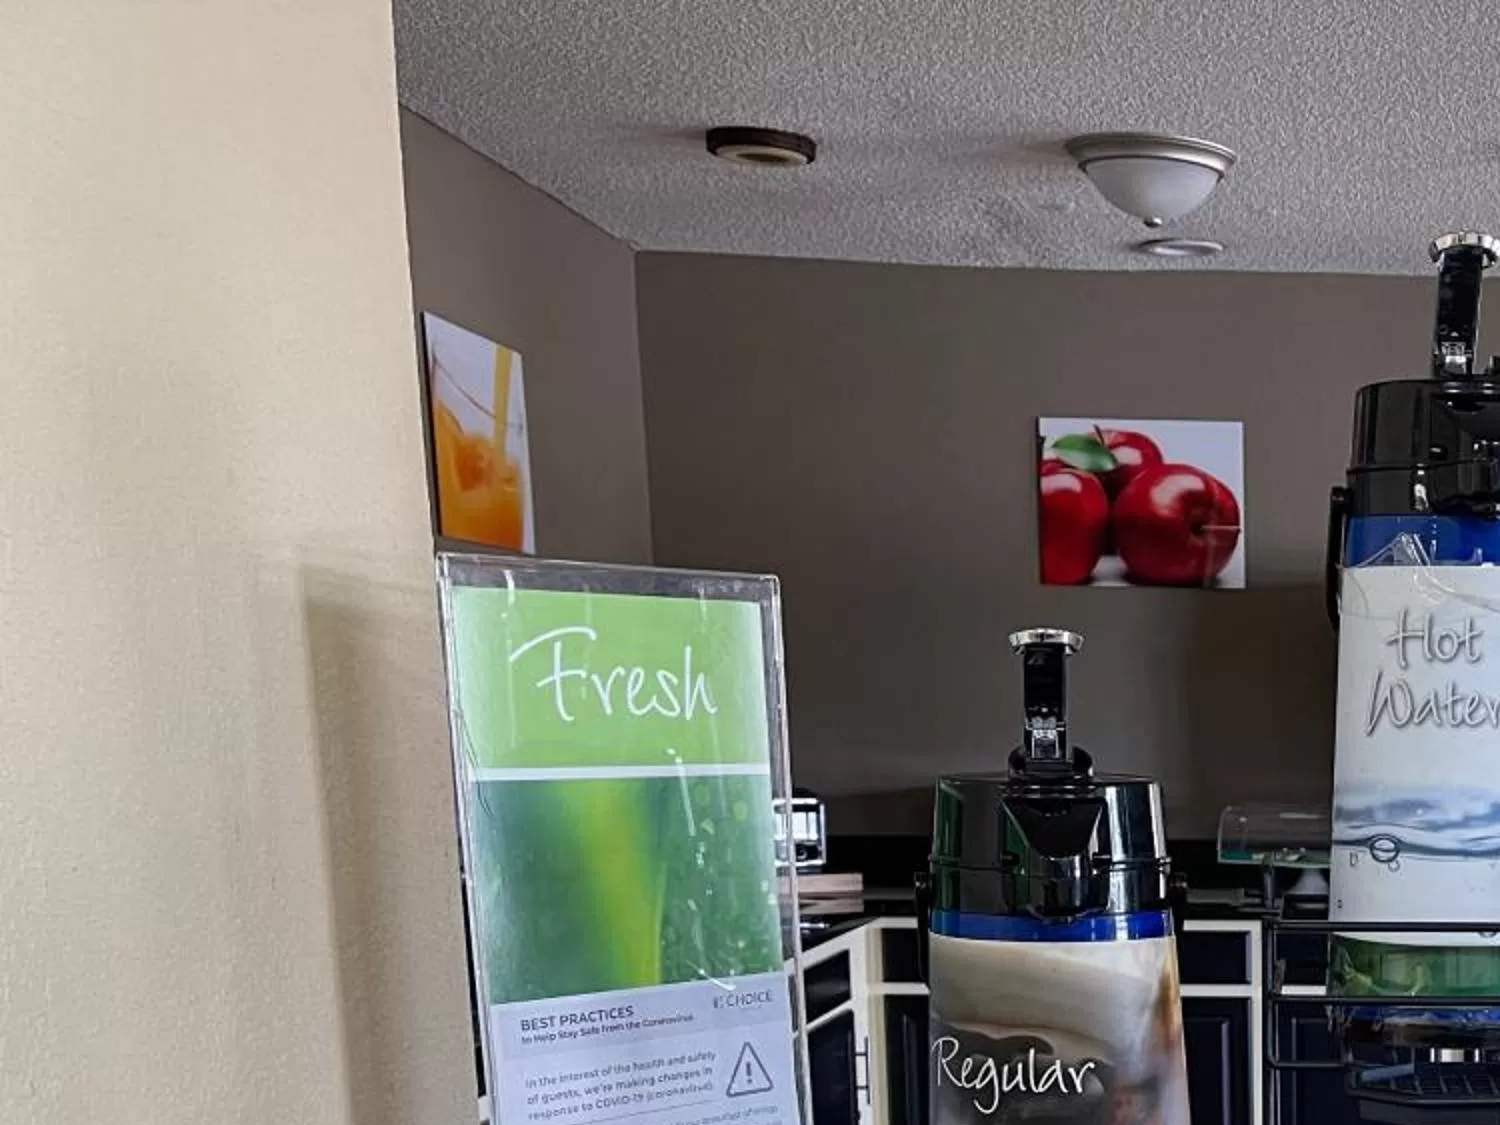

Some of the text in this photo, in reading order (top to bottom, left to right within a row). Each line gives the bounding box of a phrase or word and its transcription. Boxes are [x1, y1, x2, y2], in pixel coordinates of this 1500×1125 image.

[1386, 604, 1484, 670] Hot
[507, 626, 717, 721] Fresh
[726, 989, 773, 1007] CHOICE
[520, 1005, 635, 1032] BEST PRACTICES
[557, 1029, 579, 1039] Stay
[580, 1026, 600, 1037] Safe
[527, 1095, 539, 1105] of
[615, 1075, 655, 1091] making
[658, 1070, 700, 1083] changes
[703, 1066, 713, 1076] in
[539, 1076, 557, 1087] the
[559, 1068, 600, 1083] interest
[601, 1065, 612, 1076] of
[613, 1064, 631, 1075] the
[632, 1057, 665, 1072] health
[667, 1055, 686, 1067] and
[688, 1050, 717, 1063] safety
[931, 1036, 1095, 1115] Regular
[528, 1105, 579, 1121] response
[581, 1101, 593, 1111] to
[595, 1093, 644, 1109] COVID-19
